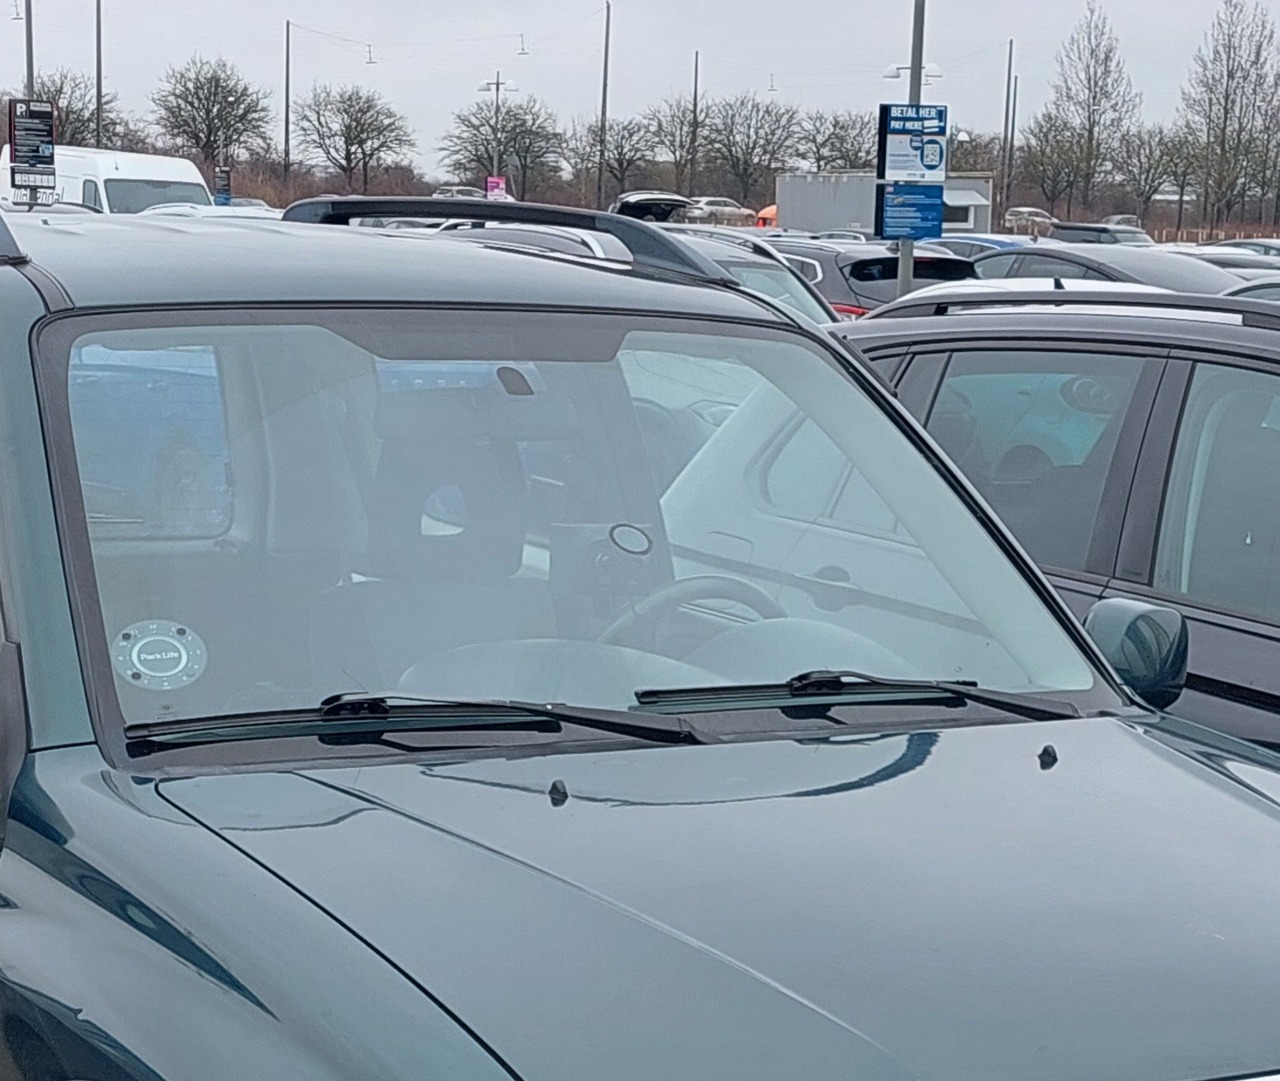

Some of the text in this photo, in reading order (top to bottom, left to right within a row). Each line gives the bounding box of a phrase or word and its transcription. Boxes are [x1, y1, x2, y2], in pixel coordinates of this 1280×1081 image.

[890, 106, 937, 118] BETAL HER
[890, 120, 904, 130] PAY
